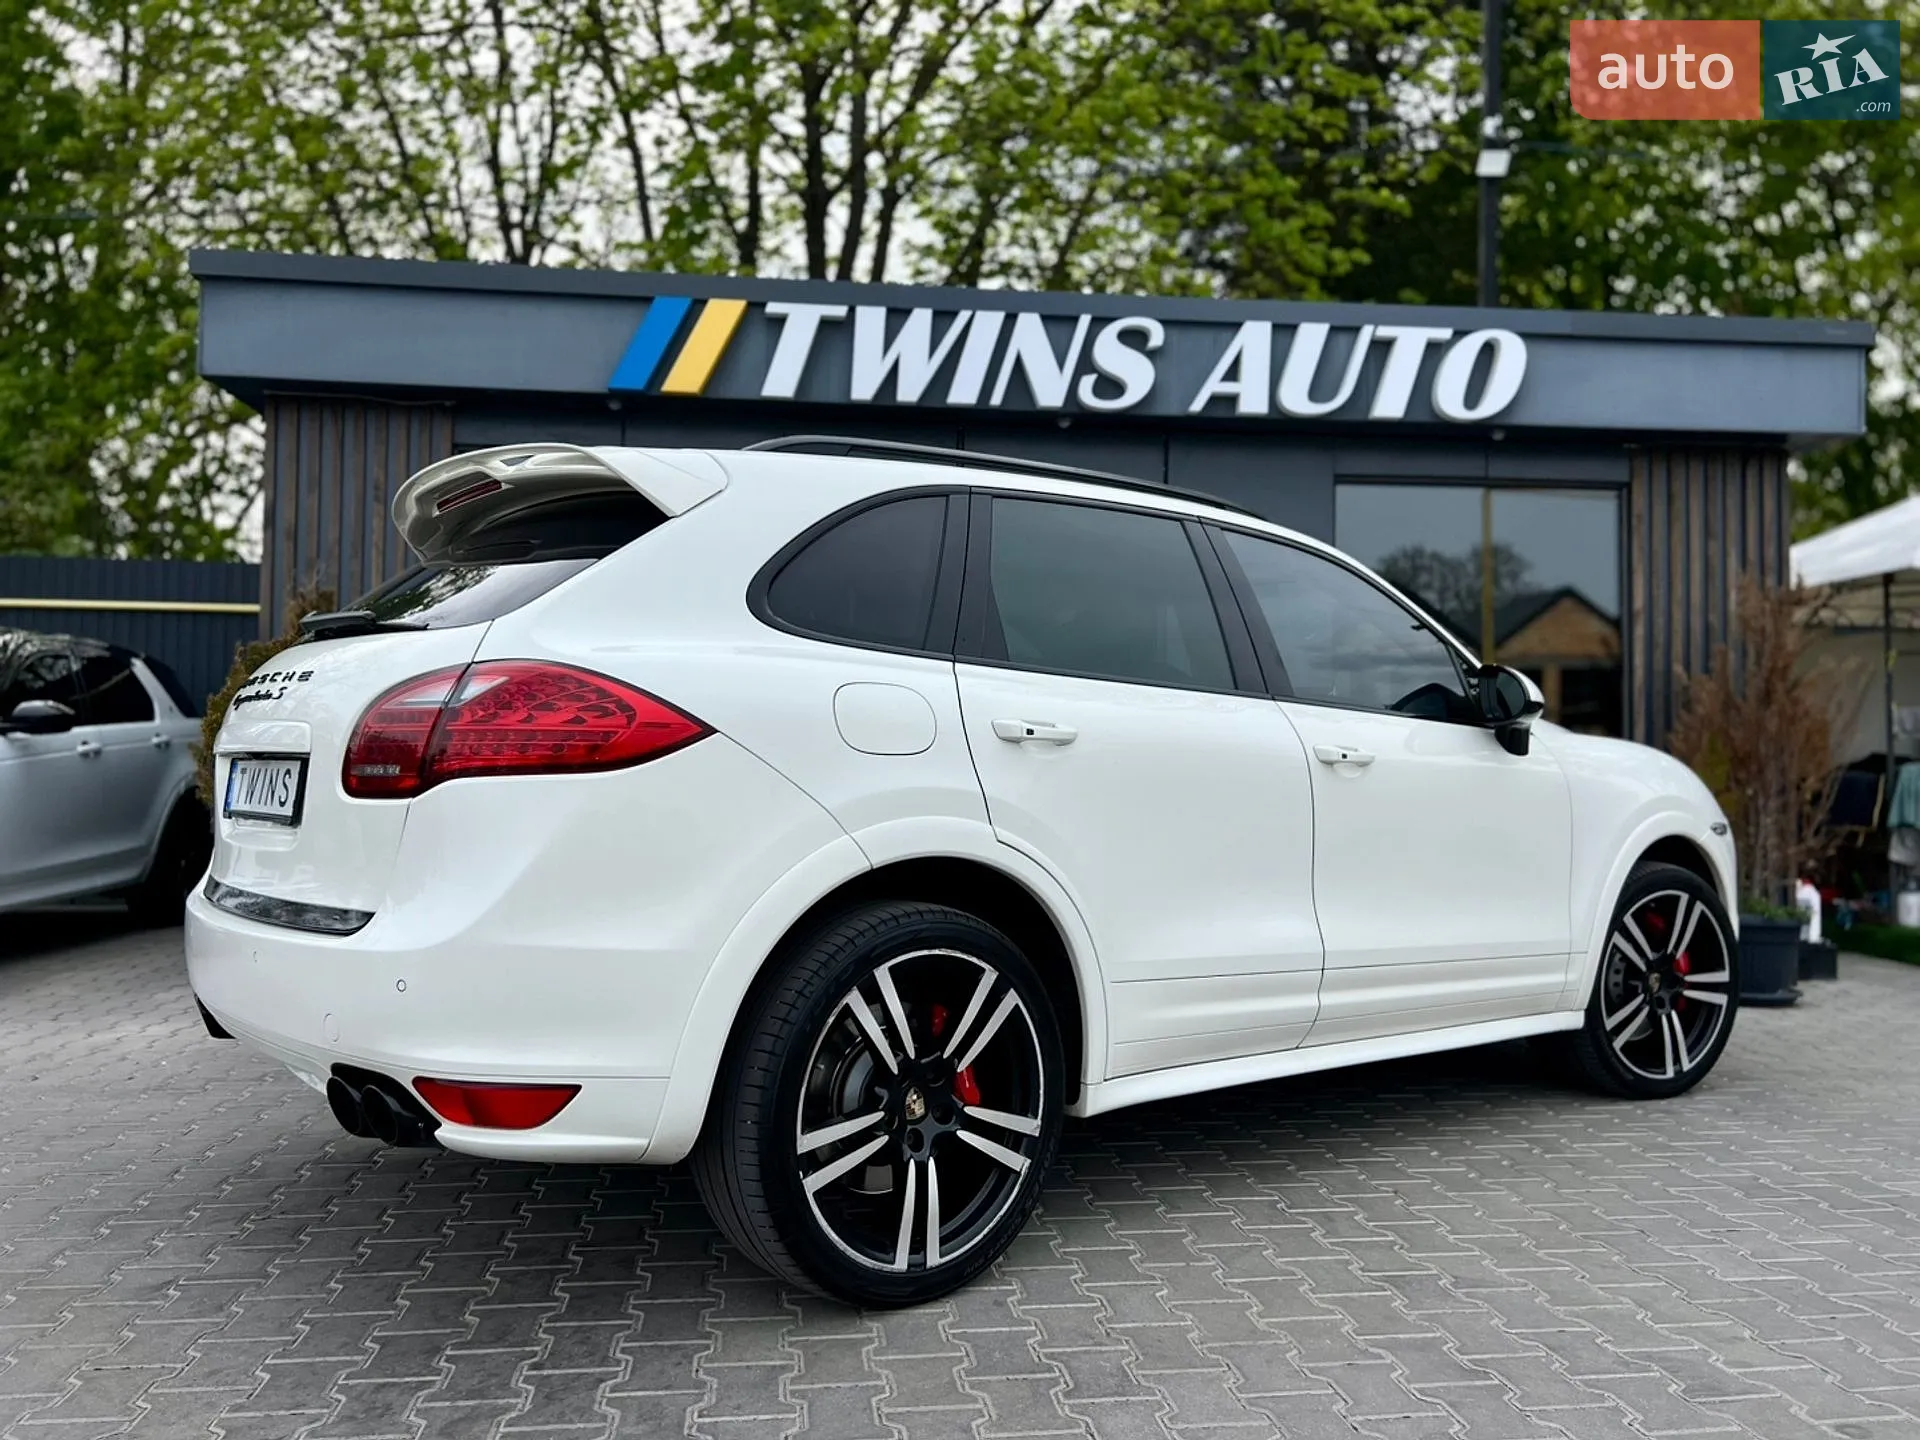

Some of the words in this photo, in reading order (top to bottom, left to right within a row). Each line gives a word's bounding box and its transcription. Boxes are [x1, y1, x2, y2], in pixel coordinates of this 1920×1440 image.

[760, 301, 1166, 412] TWINS
[1188, 319, 1528, 422] AUTO
[237, 767, 292, 808] TWINS
